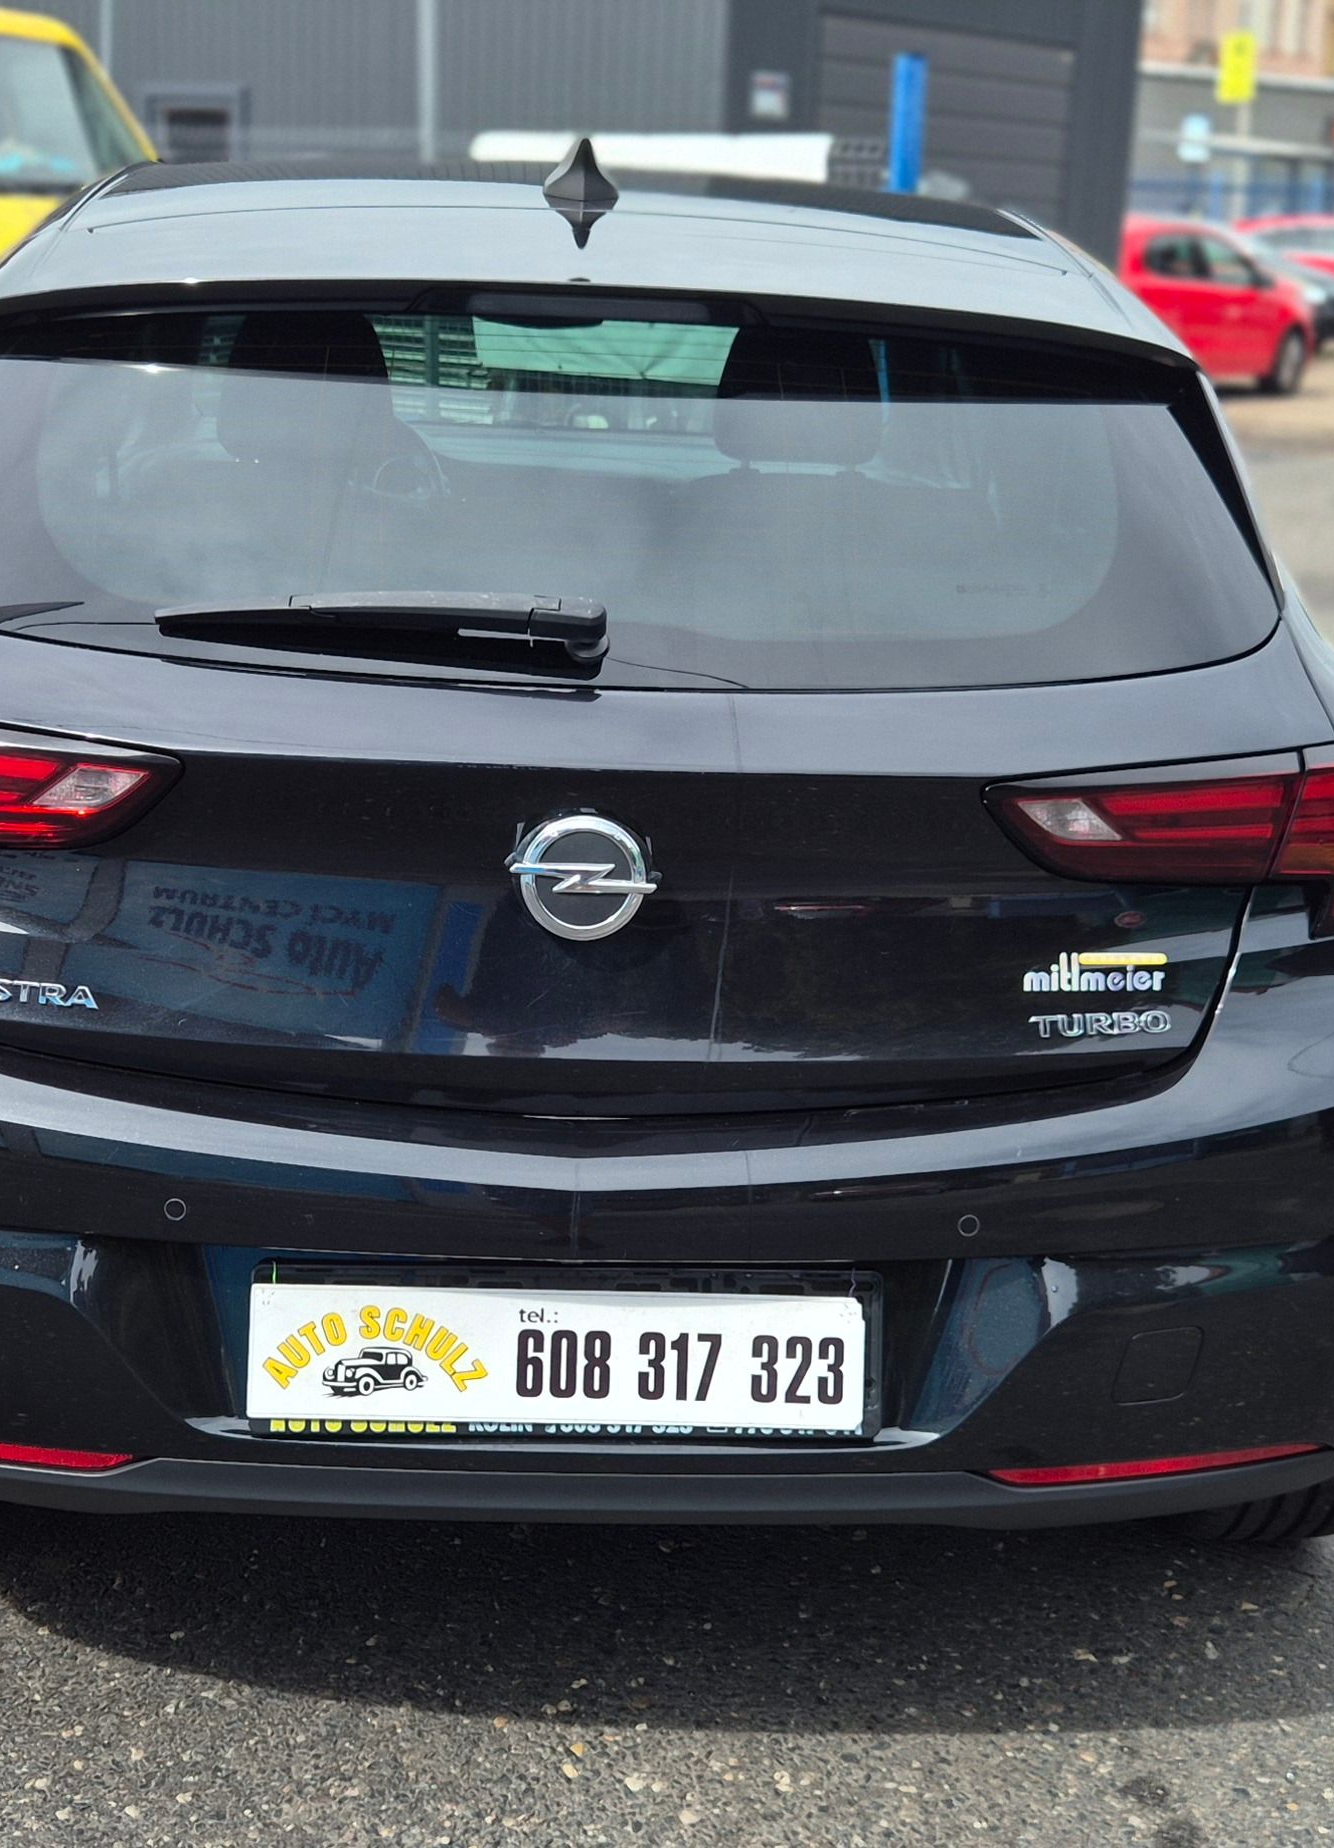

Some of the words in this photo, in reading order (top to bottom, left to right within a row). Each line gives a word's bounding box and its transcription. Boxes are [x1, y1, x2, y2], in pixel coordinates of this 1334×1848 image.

[148, 906, 277, 959] SCHULZ
[1028, 1010, 1172, 1038] TURBO
[519, 1308, 559, 1323] tel.:
[262, 1312, 348, 1390] AUTO
[358, 1304, 489, 1393] SCHULZ
[516, 1329, 612, 1399] 608
[638, 1331, 723, 1402] 317
[750, 1334, 845, 1405] 323
